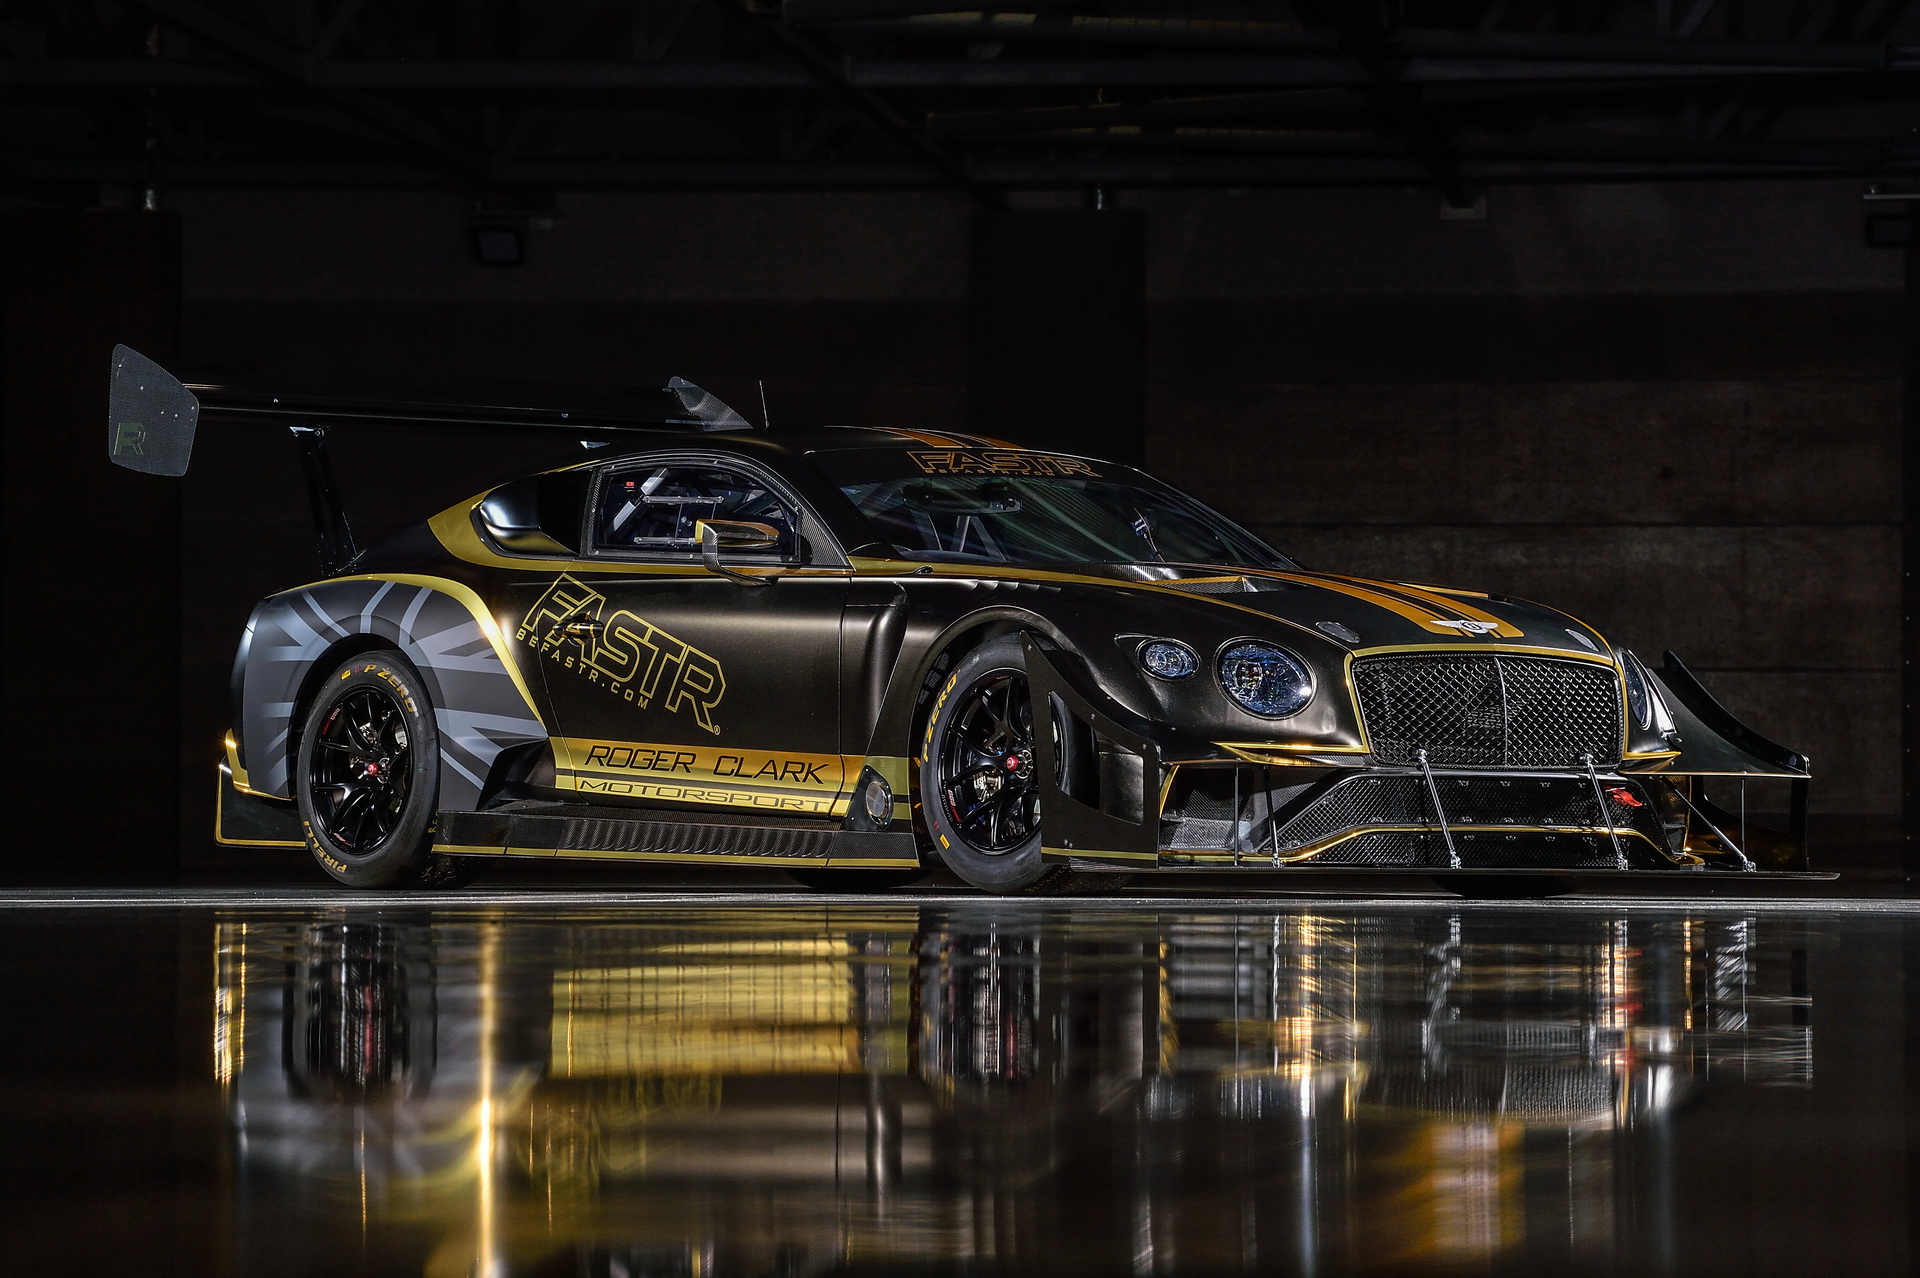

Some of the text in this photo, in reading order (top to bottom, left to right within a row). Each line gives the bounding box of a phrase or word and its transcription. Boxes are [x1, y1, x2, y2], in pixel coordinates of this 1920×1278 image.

[906, 450, 1103, 478] FASTR
[924, 468, 1055, 477] BEFASTR.COM
[363, 663, 418, 713] P ZERO
[515, 627, 650, 710] BEFASTR.COM
[927, 673, 957, 743] ZERO
[585, 745, 829, 784] ROGER CLARK
[579, 780, 829, 812] MOTORSPORT
[303, 820, 348, 873] PIRELLI
